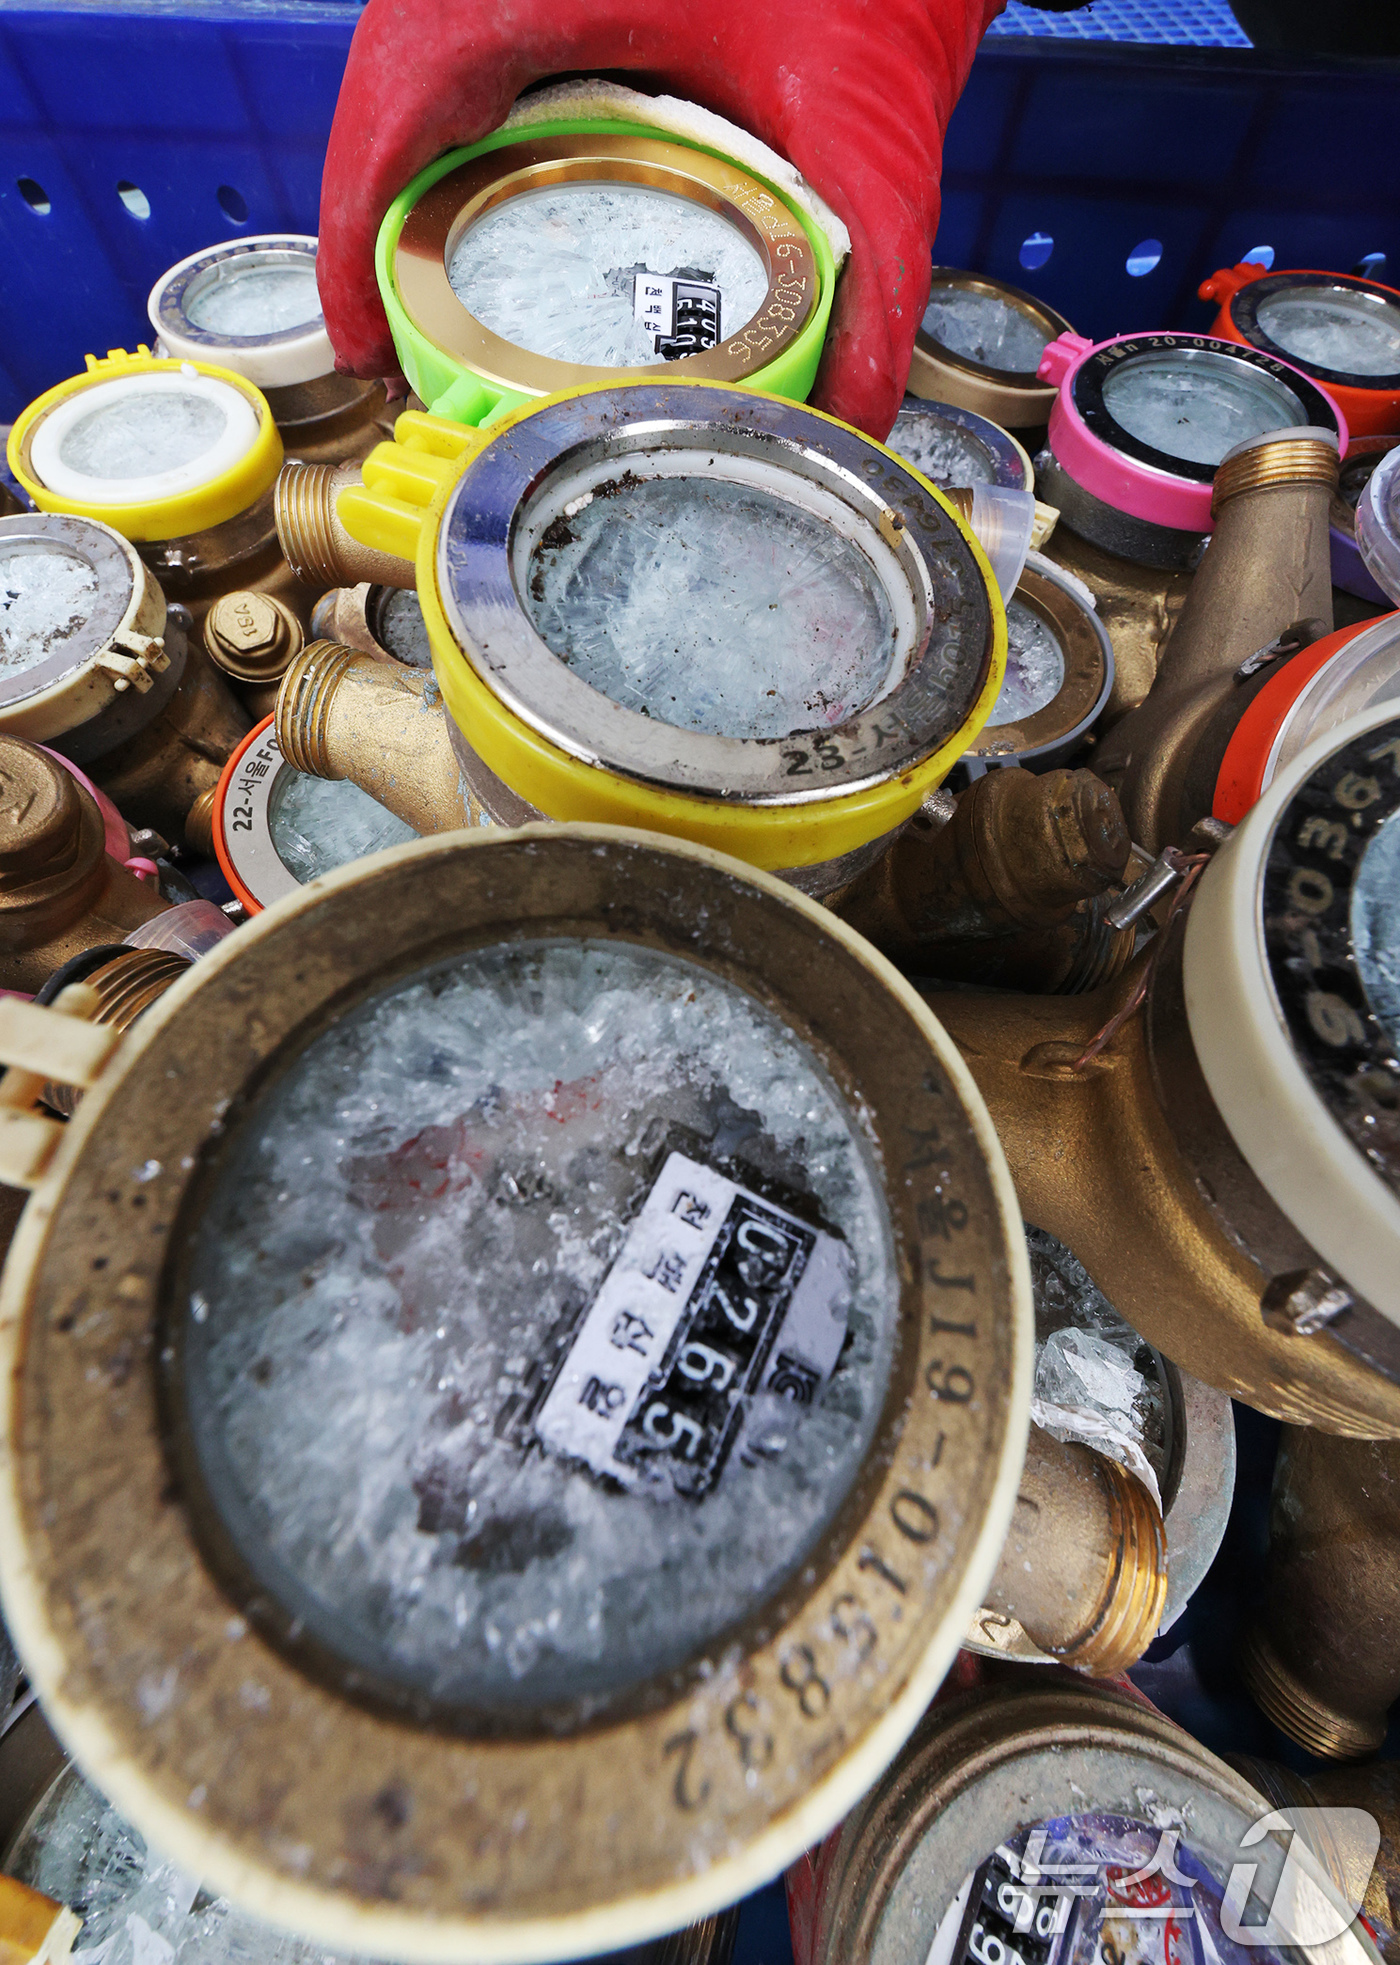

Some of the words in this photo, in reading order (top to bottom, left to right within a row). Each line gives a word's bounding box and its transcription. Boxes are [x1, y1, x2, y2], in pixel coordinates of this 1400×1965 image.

[670, 1190, 712, 1231] 천
[642, 1251, 688, 1293] 백
[609, 1310, 655, 1357] 십
